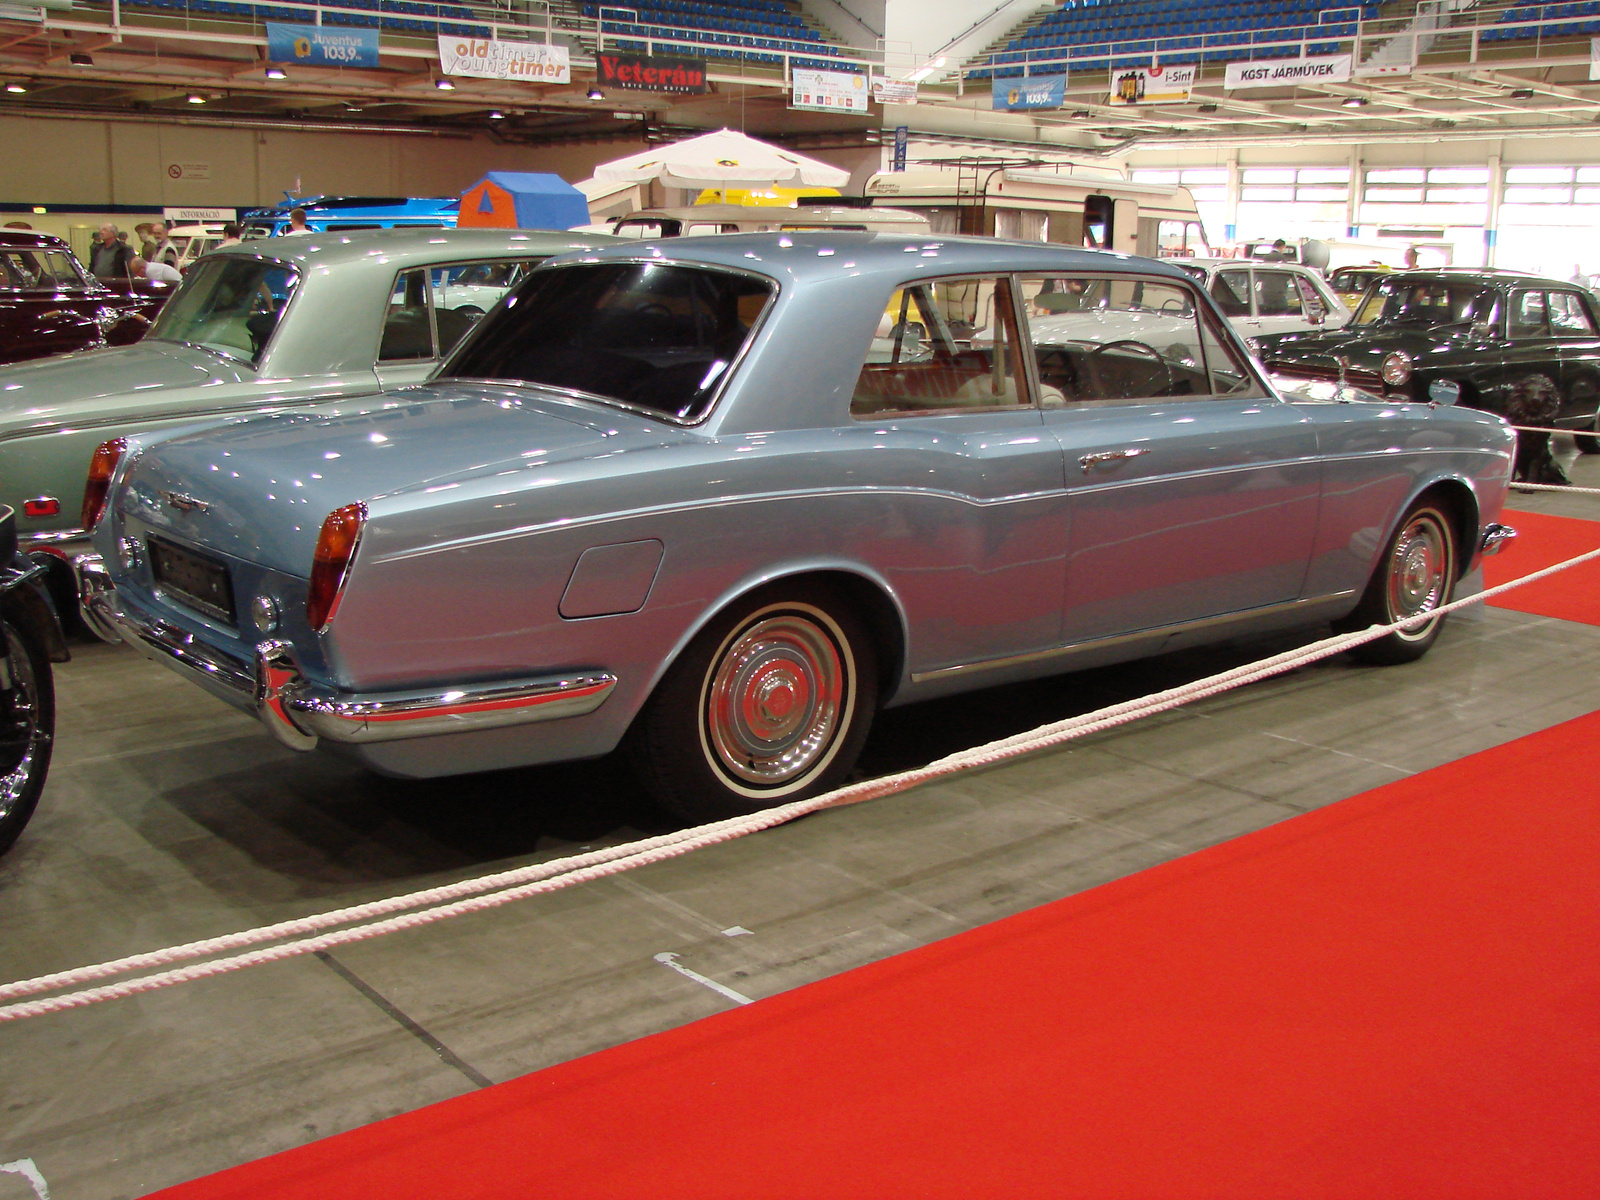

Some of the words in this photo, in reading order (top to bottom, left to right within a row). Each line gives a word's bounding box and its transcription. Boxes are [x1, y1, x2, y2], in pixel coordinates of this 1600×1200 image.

[312, 33, 362, 47] Juventus
[322, 45, 356, 62] 103,9
[456, 40, 547, 63] oldtimer
[447, 56, 566, 79] youngtimer
[600, 55, 702, 86] Veterán
[1165, 70, 1191, 82] i-Sint
[1241, 67, 1270, 81] KGST
